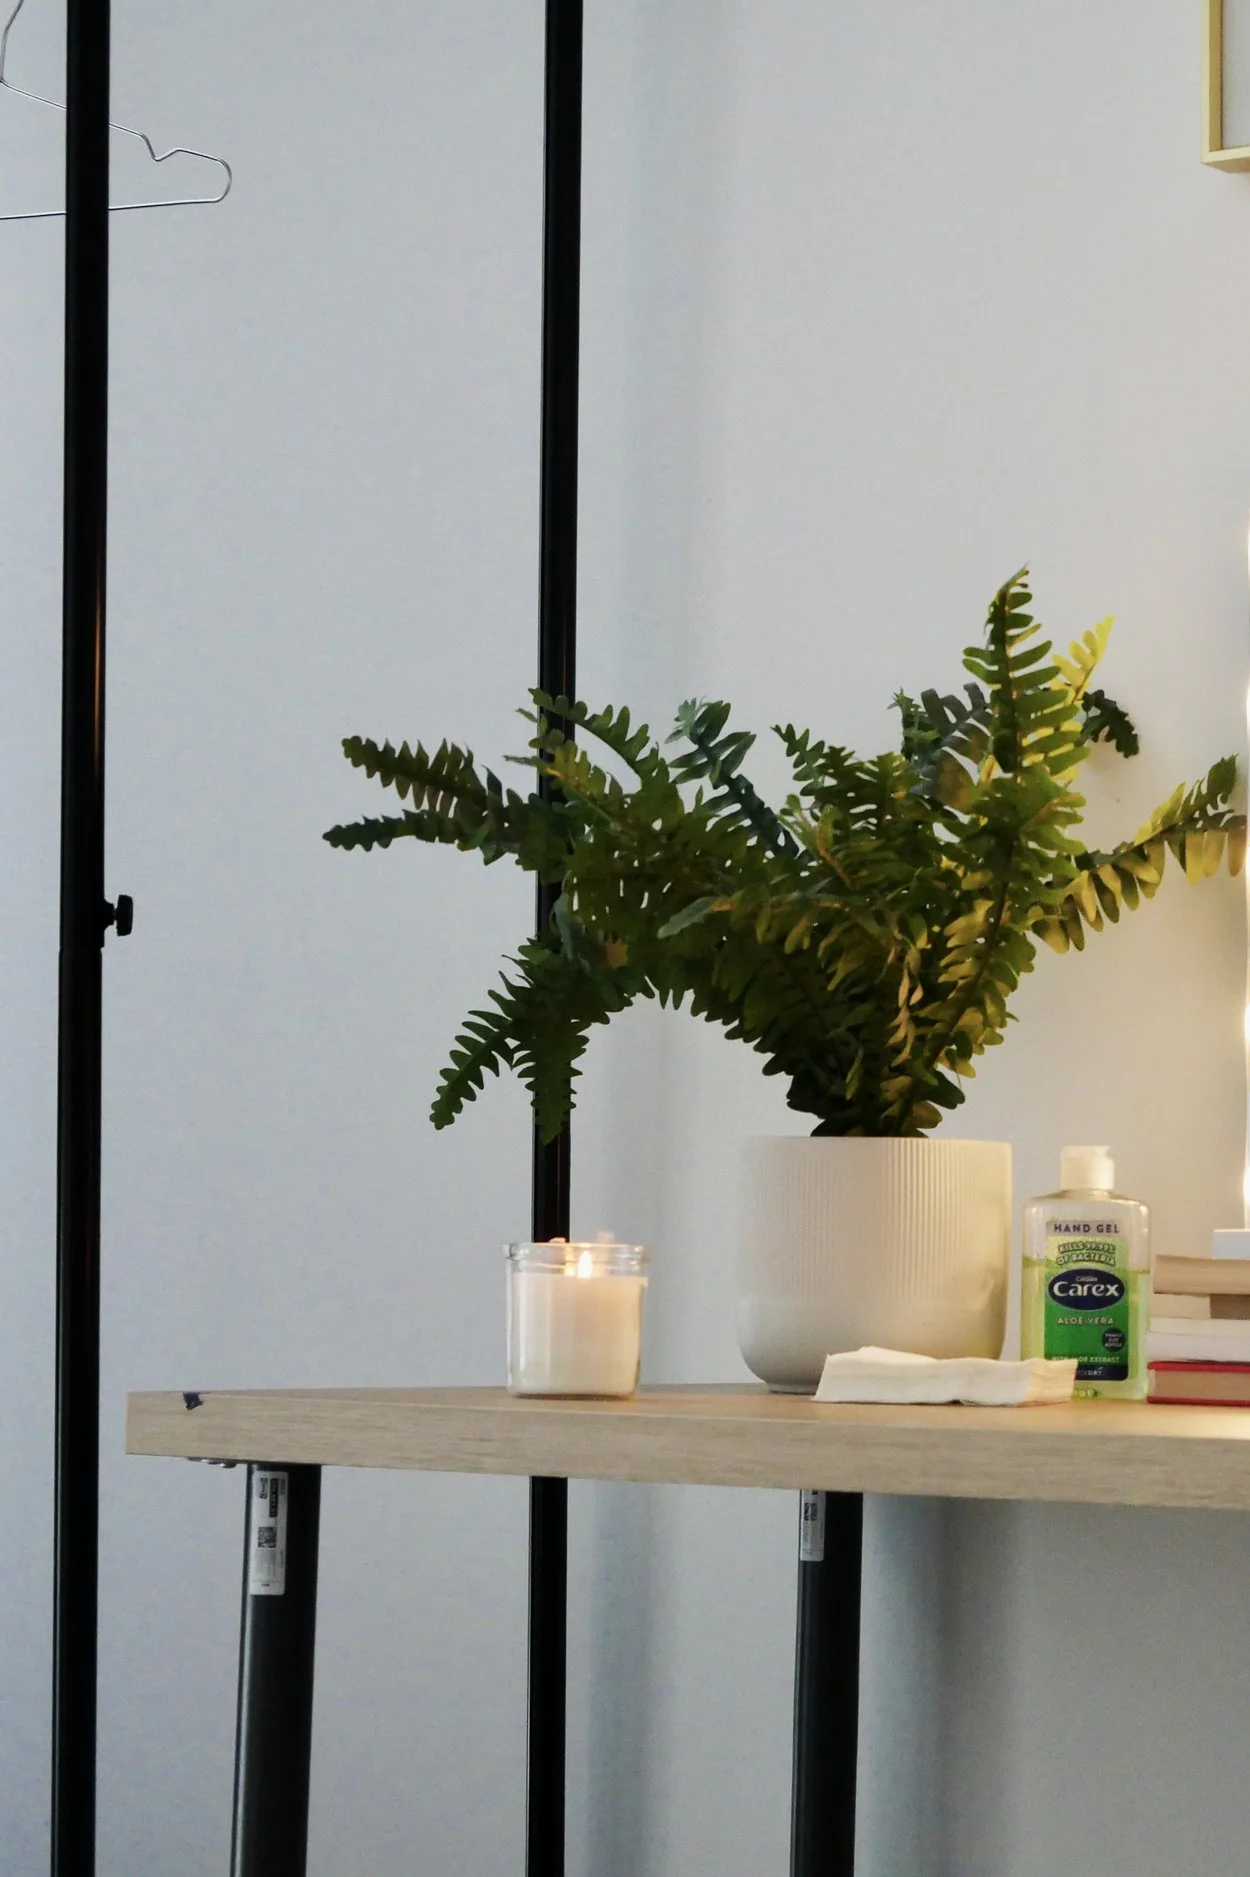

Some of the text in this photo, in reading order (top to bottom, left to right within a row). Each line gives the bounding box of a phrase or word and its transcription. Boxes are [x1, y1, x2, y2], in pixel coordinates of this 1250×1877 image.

[1053, 1223, 1120, 1233] HAND GEL
[1057, 1253, 1116, 1266] OF BACTERIA
[1053, 1281, 1120, 1297] Carex
[1057, 1317, 1114, 1325] ALOE VERA
